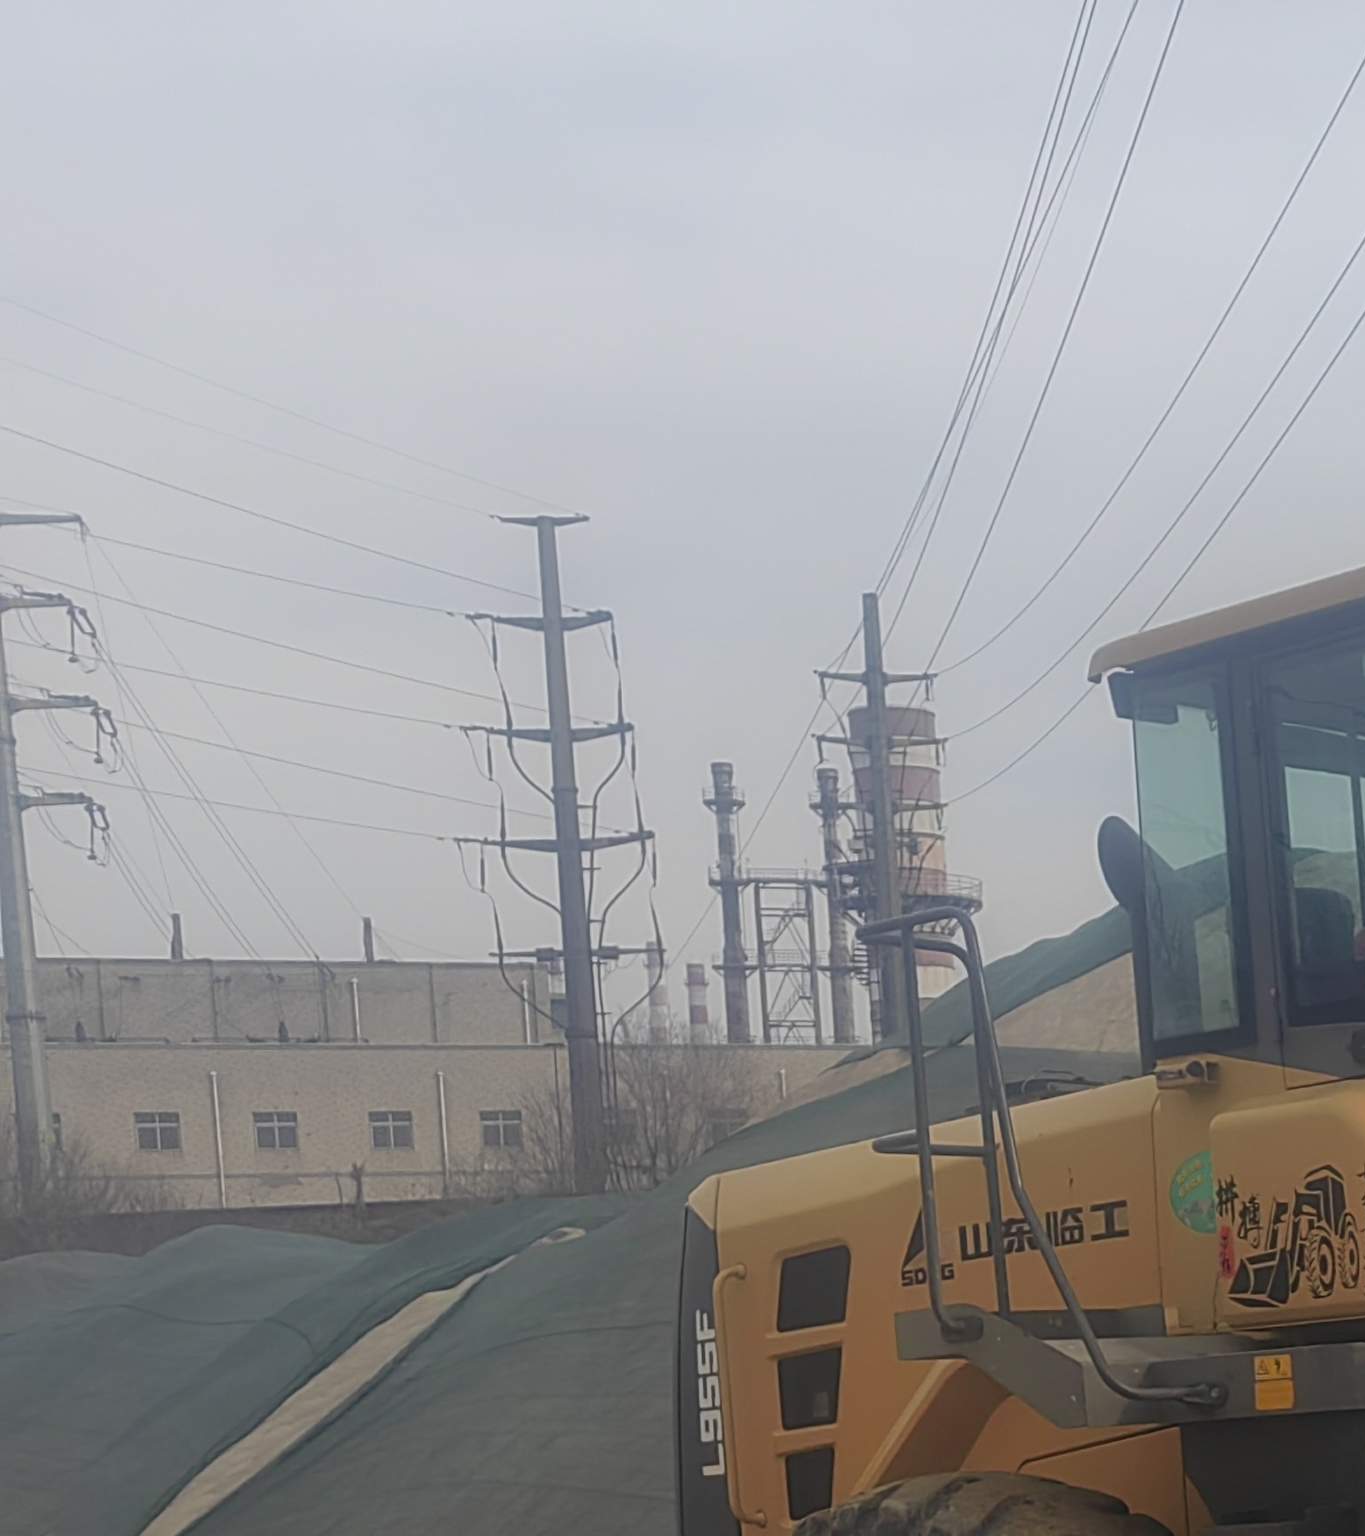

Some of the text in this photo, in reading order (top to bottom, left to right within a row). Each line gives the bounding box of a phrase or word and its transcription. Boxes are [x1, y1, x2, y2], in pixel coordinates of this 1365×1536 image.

[959, 1200, 1130, 1261] 山东临工
[901, 1263, 955, 1288] SDG
[696, 1309, 726, 1476] L955F
